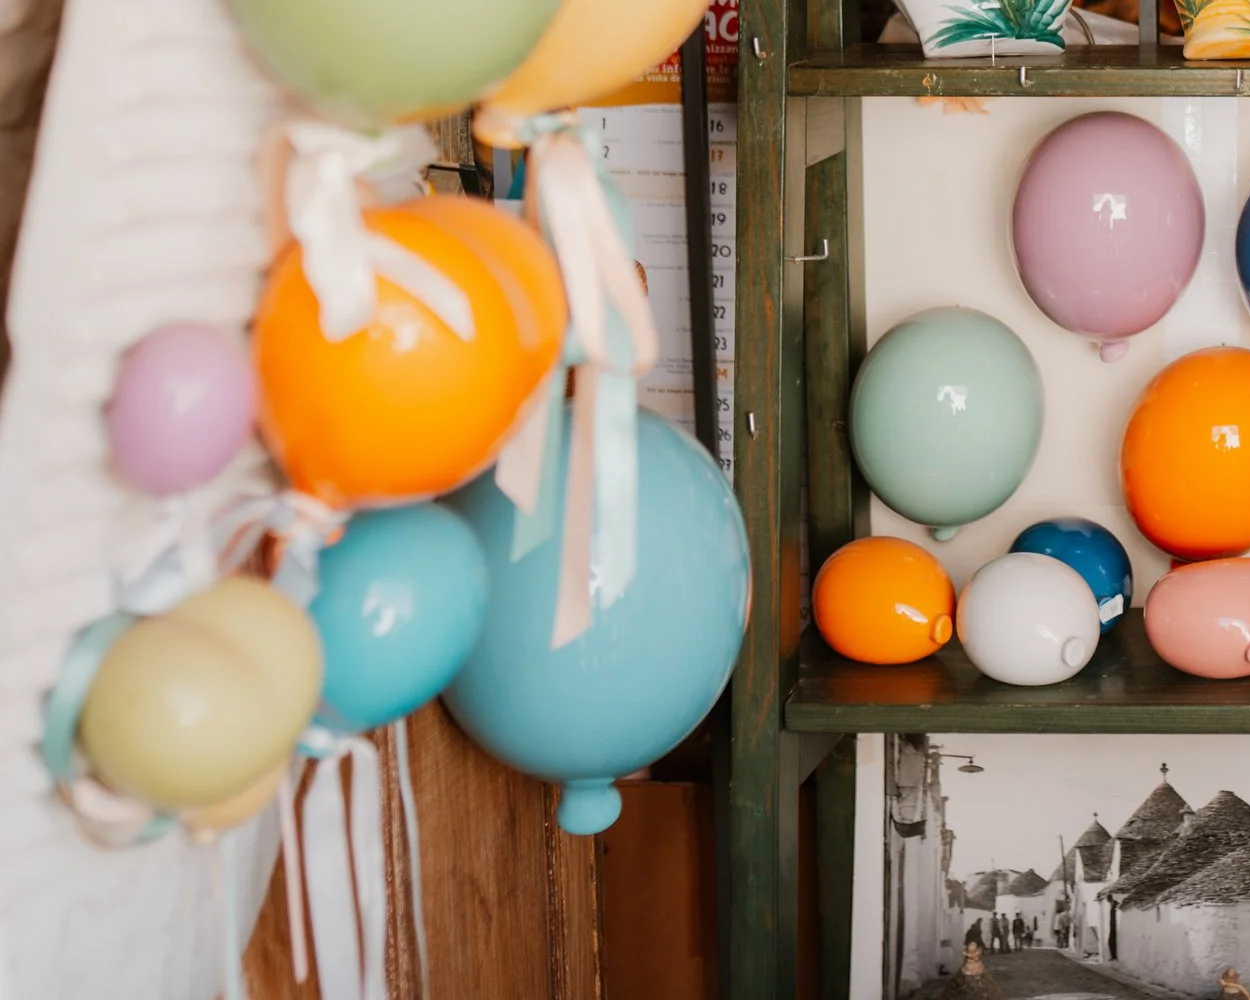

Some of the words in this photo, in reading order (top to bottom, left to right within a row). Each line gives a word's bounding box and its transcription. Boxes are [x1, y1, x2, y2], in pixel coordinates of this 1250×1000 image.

[710, 119, 724, 133] 16
[711, 150, 724, 163] 17
[711, 181, 728, 195] 18
[711, 212, 727, 226] 19
[712, 243, 732, 258] 20
